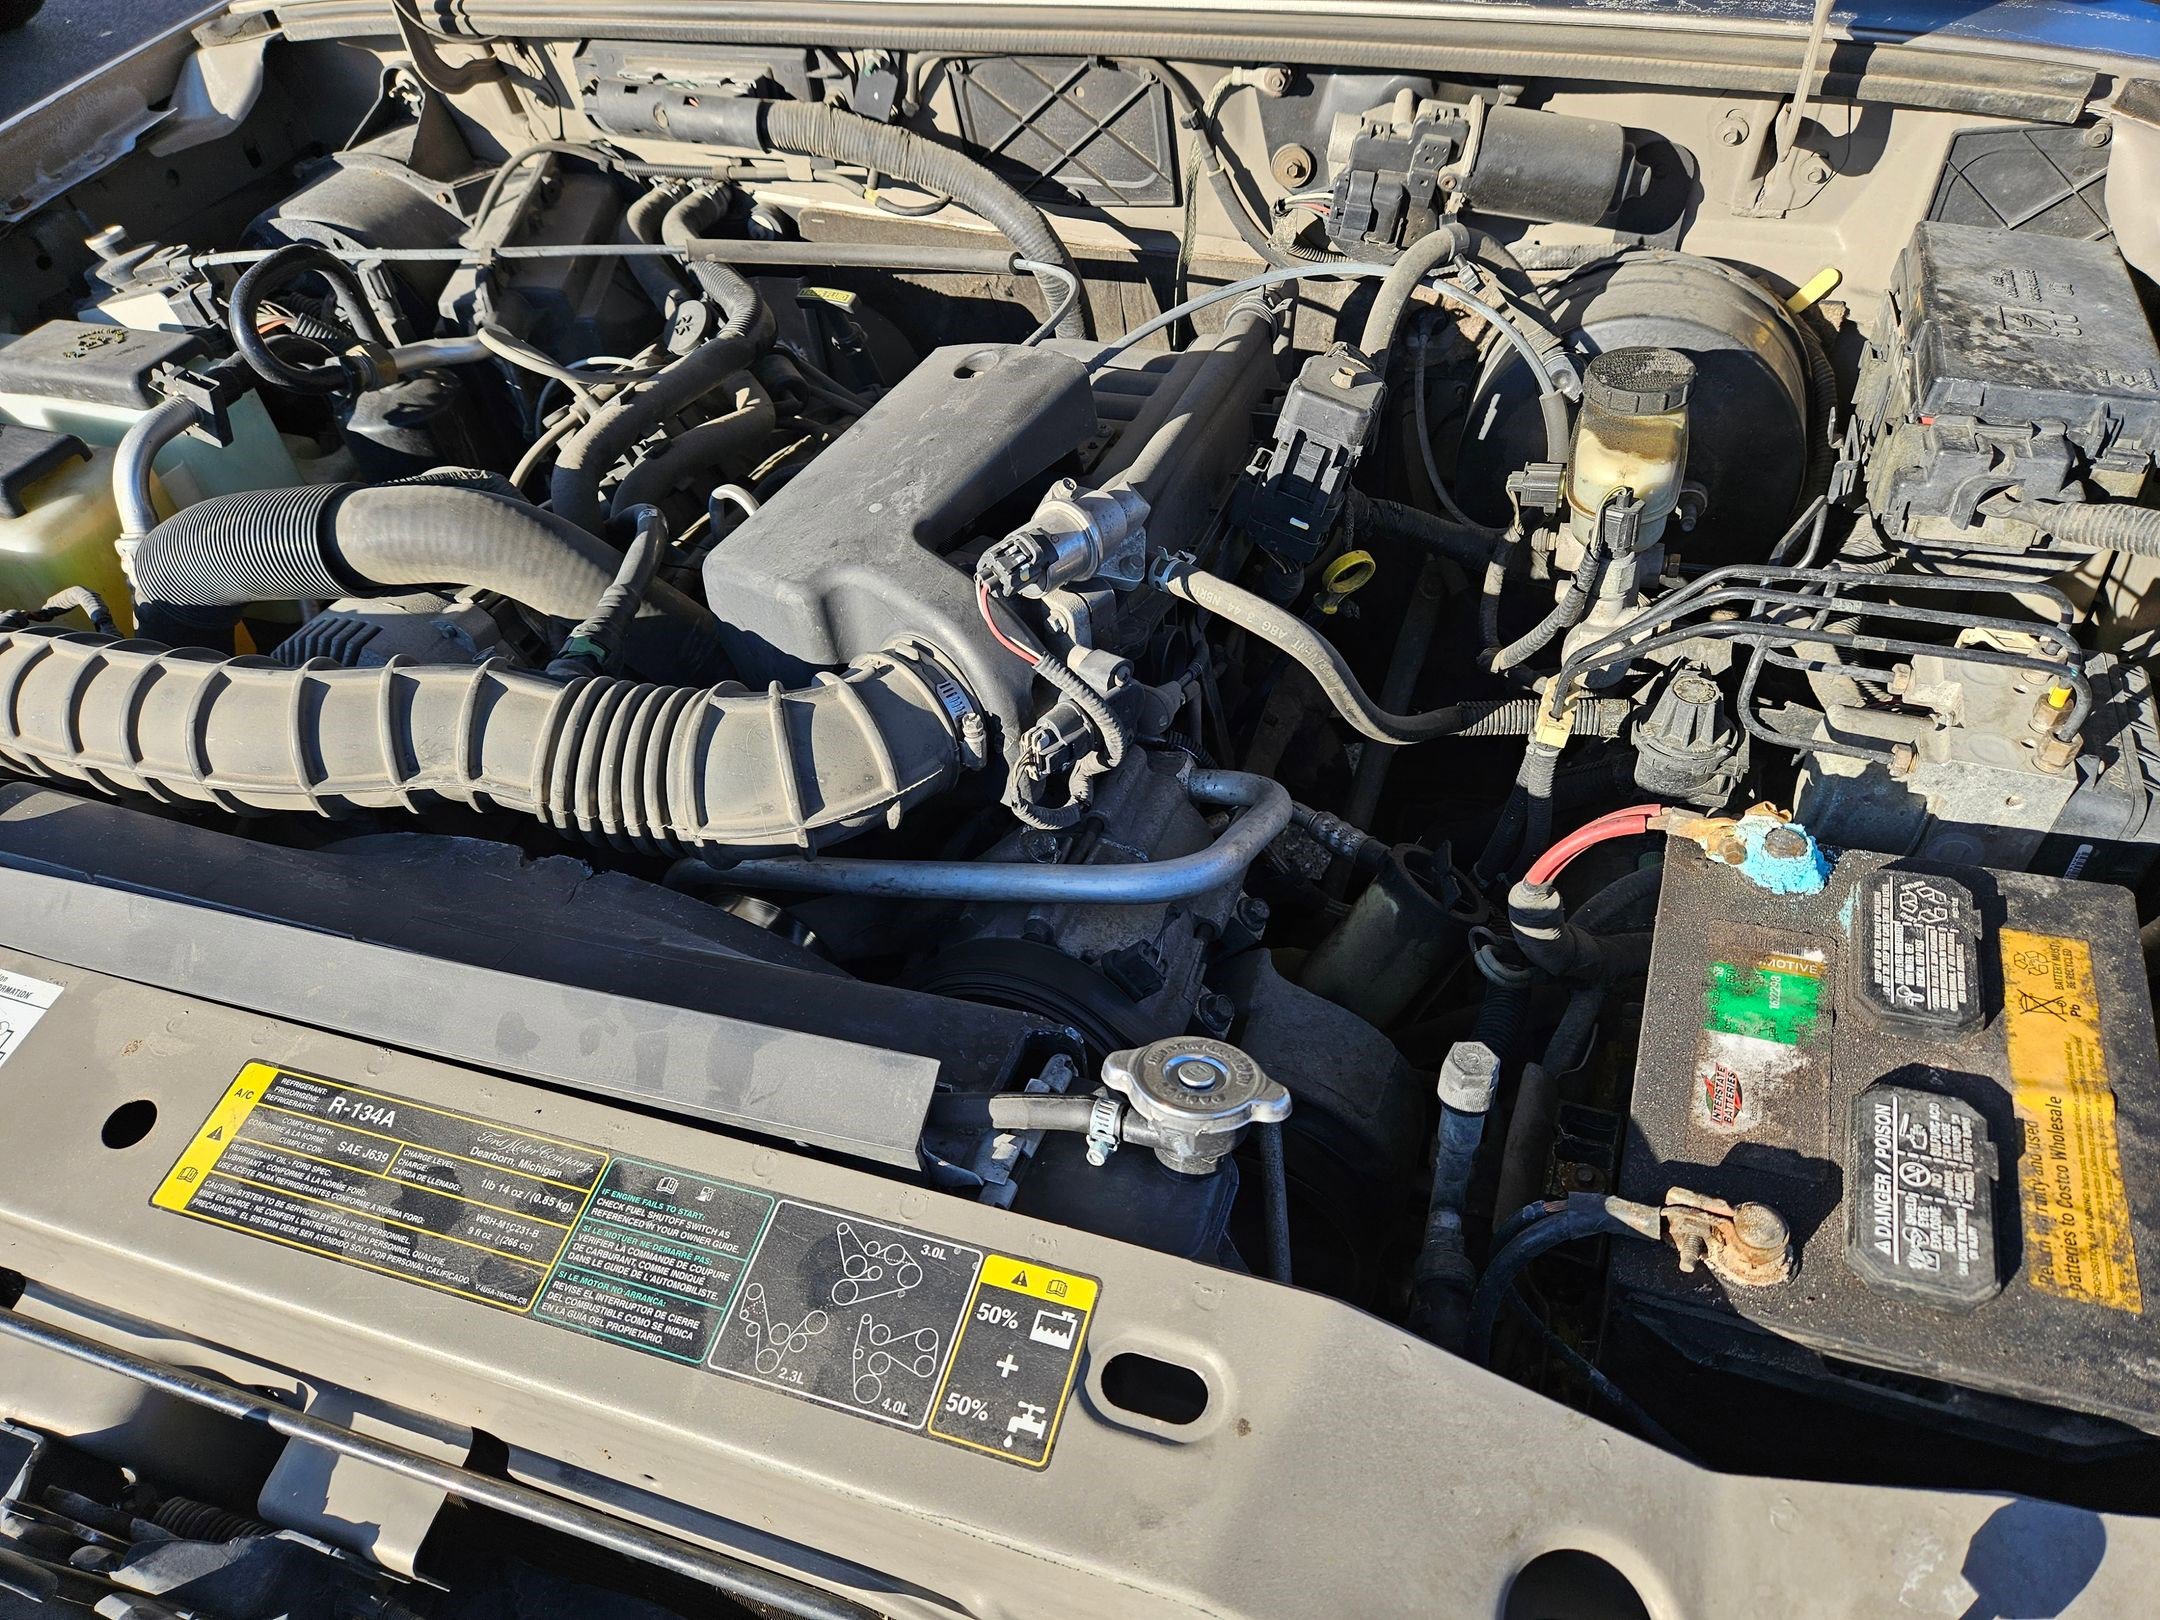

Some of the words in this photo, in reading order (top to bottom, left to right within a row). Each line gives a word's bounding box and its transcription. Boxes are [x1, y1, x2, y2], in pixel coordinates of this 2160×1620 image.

[2049, 943, 2061, 961] MUST
[2063, 949, 2075, 979] RECYCLED
[2052, 963, 2064, 990] BATTERY
[2066, 980, 2076, 989] BE
[2069, 1005, 2081, 1017] Pb
[234, 1088, 254, 1099] A/C
[281, 1078, 327, 1094] REFRIGERANT:
[1712, 1066, 1725, 1121] INTERSTATE
[1724, 1072, 1735, 1123] BATTERIES
[265, 1093, 316, 1111] REFRIGERANTE:
[328, 1096, 395, 1127] R-134A
[281, 1117, 315, 1131] COMPLIES
[316, 1126, 335, 1136] WITH:
[1875, 1104, 1892, 1159] POISON
[2045, 1096, 2068, 1161] Wholesale
[229, 1143, 276, 1160] REFRIGERANT
[275, 1156, 286, 1164] OIL
[291, 1160, 311, 1170] FORD
[311, 1165, 332, 1176] SPEC:
[278, 1136, 306, 1149] CUMPLE
[306, 1144, 323, 1153] CON:
[337, 1141, 362, 1155] SAE
[362, 1148, 389, 1162] J639
[403, 1149, 432, 1162] CHARGE
[432, 1157, 456, 1169] LEVEL:
[477, 1131, 505, 1147] Ford
[502, 1138, 538, 1156] Motor
[538, 1145, 595, 1173] Company
[397, 1158, 428, 1171] CHARGE:
[470, 1146, 514, 1166] Dearborn,
[517, 1158, 562, 1177] Michigan
[217, 1160, 232, 1169] USE
[231, 1164, 256, 1176] ACEITE
[255, 1171, 274, 1181] PARA
[274, 1176, 330, 1197] REFRIGERANTES
[331, 1192, 370, 1208] CONFORME
[376, 1205, 402, 1217] NORMA
[402, 1212, 424, 1224] FORD:
[391, 1167, 415, 1178] CARGA
[416, 1173, 427, 1181] DE
[426, 1176, 460, 1191] LLENADO:
[2055, 1165, 2073, 1208] Costco
[498, 1183, 510, 1194] 14
[510, 1189, 523, 1198] oz
[529, 1192, 556, 1206] (0.85
[555, 1199, 573, 1213] kg)
[610, 1190, 641, 1203] ENGINE
[641, 1198, 664, 1209] FAILS
[665, 1204, 676, 1213] TO
[677, 1208, 705, 1220] START:
[236, 1189, 264, 1201] SYSTEM
[264, 1196, 275, 1205] TO
[274, 1200, 286, 1208] BE
[285, 1203, 319, 1217] SERVICED
[319, 1212, 331, 1220] BY
[330, 1216, 367, 1231] QUALIFIED
[367, 1226, 410, 1244] PERSONNEL.
[591, 1207, 645, 1227] REFERENCED
[645, 1221, 656, 1230] IN
[656, 1224, 679, 1236] YOUR
[680, 1231, 711, 1245] OWNER
[712, 1240, 739, 1253] GUIDE.
[596, 1197, 625, 1210] CHECK
[625, 1205, 645, 1216] FUEL
[647, 1211, 685, 1226] SHUTOFF
[685, 1221, 718, 1235] SWITCH
[717, 1230, 730, 1238] AS
[2059, 1213, 2074, 1226] to
[238, 1211, 248, 1220] EL
[249, 1214, 279, 1228] SISTEMA
[279, 1223, 299, 1234] DEBE
[298, 1228, 314, 1238] SER
[314, 1233, 349, 1248] ATENDIDO
[349, 1243, 370, 1254] SOLO
[369, 1249, 386, 1259] POR
[386, 1254, 424, 1271] PERSONAL
[426, 1265, 469, 1284] CALIFICADO.
[467, 1226, 474, 1234] 9
[474, 1228, 481, 1236] fl
[481, 1232, 492, 1240] oz
[519, 1242, 533, 1252] cc)
[582, 1224, 591, 1232] SI
[693, 1255, 712, 1265] PAS:
[920, 1244, 946, 1260] 3.0L
[567, 1252, 591, 1264] DANS
[591, 1258, 603, 1268] LE
[603, 1262, 630, 1275] GUIDE
[630, 1269, 643, 1279] DE
[572, 1242, 584, 1251] DE
[638, 1261, 669, 1275] COMME
[670, 1269, 705, 1285] INDIQUÉ
[614, 1243, 626, 1253] LA
[627, 1247, 675, 1266] COMMANDE
[675, 1260, 688, 1269] DE
[689, 1264, 730, 1281] COUPURE
[2062, 1231, 2082, 1291] batteries
[558, 1270, 567, 1278] SI
[567, 1273, 579, 1282] LE
[579, 1276, 609, 1290] MOTOR
[610, 1285, 623, 1294] NO
[624, 1289, 666, 1306] ARRANCA:
[546, 1291, 562, 1302] DEL
[565, 1296, 623, 1319] COMBUSTIBLE
[624, 1313, 650, 1327] COMO
[651, 1321, 664, 1331] SE
[663, 1325, 692, 1340] INDICA
[552, 1280, 583, 1295] REVISE
[583, 1289, 593, 1299] EL
[595, 1293, 653, 1315] INTERRUPTOR
[653, 1309, 667, 1320] DE
[667, 1313, 699, 1329] CIERRE
[977, 1303, 1017, 1328] 50%
[541, 1302, 554, 1311] EN
[554, 1305, 565, 1315] LA
[587, 1315, 604, 1327] DEL
[606, 1321, 662, 1344] PROPIETARIO.
[777, 1367, 803, 1384] 2.3L
[881, 1398, 907, 1415] 4.0L
[945, 1393, 987, 1420] 50%
